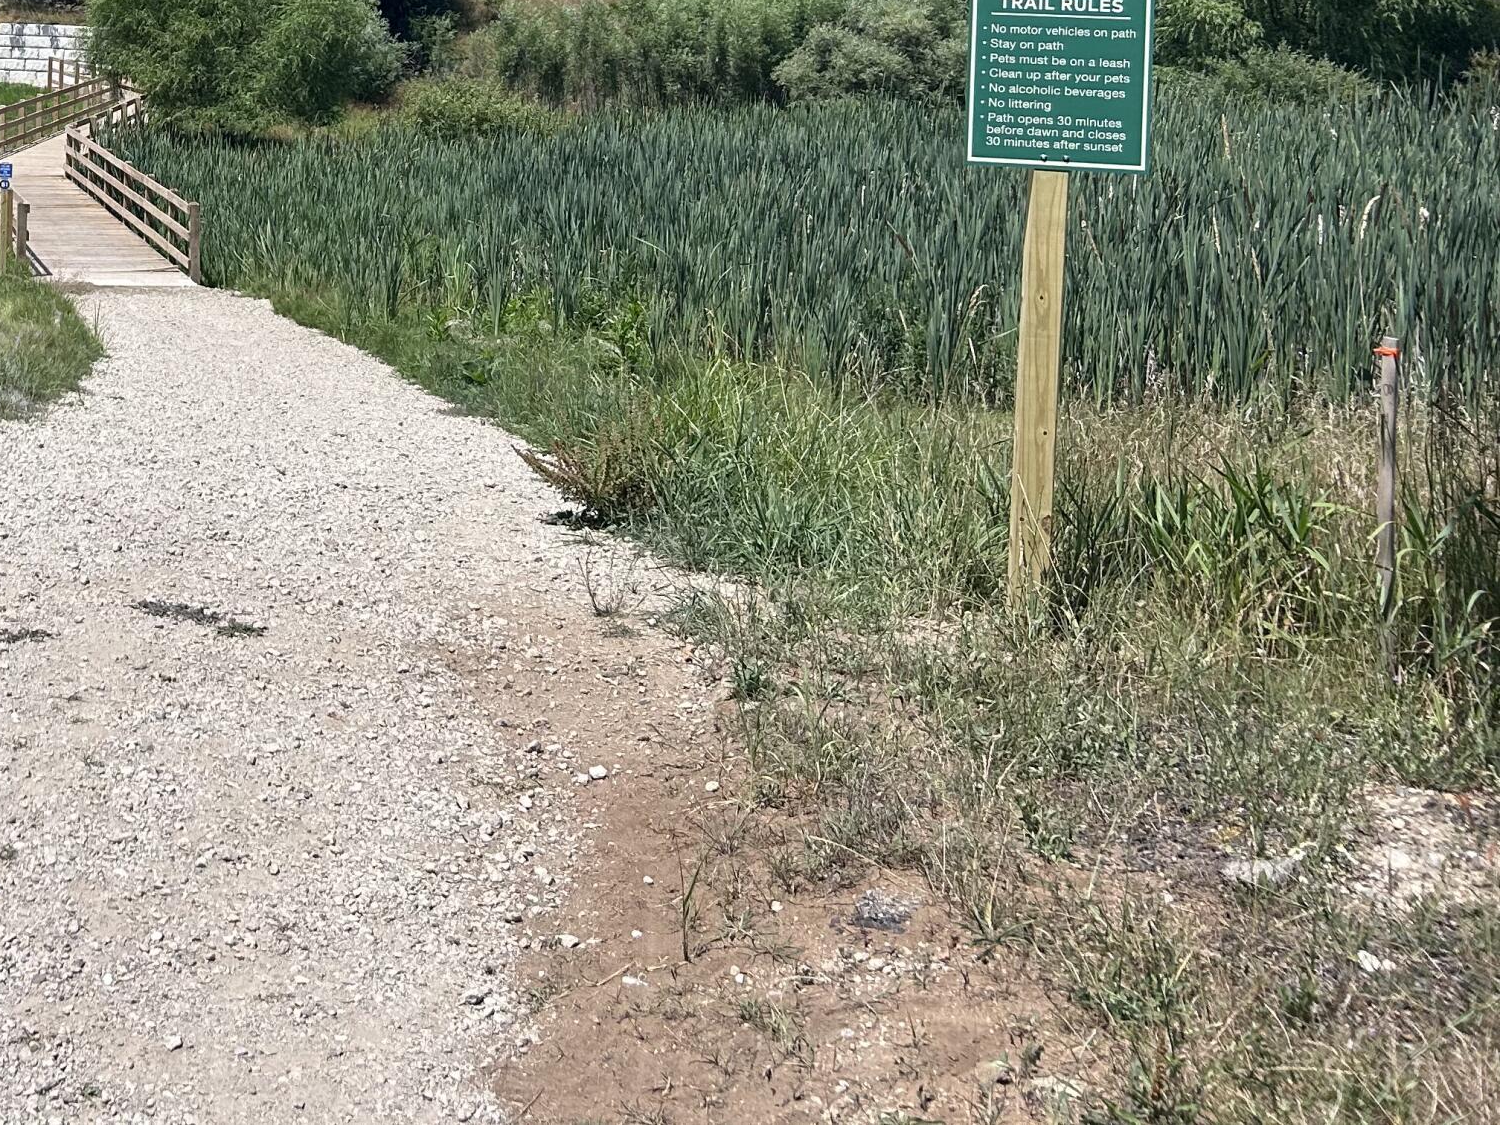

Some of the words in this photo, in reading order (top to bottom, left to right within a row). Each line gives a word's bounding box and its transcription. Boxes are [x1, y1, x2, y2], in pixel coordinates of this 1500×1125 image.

[1061, 0, 1124, 13] RULES
[991, 24, 1006, 34] No
[1010, 26, 1042, 35] motor
[1046, 27, 1090, 37] vehicles
[1093, 29, 1108, 37] on
[1111, 29, 1136, 41] path
[991, 39, 1015, 49] Stay
[1019, 41, 1034, 49] on
[1038, 40, 1063, 51] path
[990, 54, 1015, 64] Pets
[1019, 56, 1048, 65] must
[1052, 57, 1066, 66] be
[1070, 59, 1084, 67] on
[1088, 59, 1095, 67] a
[1099, 58, 1130, 68] leash
[989, 68, 1022, 78] Clean
[1026, 70, 1041, 81] up
[1044, 70, 1071, 80] after
[1075, 74, 1101, 83] your
[1105, 74, 1130, 85] pets
[989, 83, 1005, 93] No
[1009, 85, 1060, 95] alcoholic
[1065, 87, 1125, 99] beverages
[989, 98, 1005, 107] No
[1009, 99, 1051, 111] littering
[988, 113, 1014, 123] Path
[1018, 116, 1053, 125] opens
[1057, 117, 1071, 125] 30
[1075, 117, 1122, 128] minutes
[987, 125, 1023, 135] before
[1027, 127, 1058, 137] dawn
[1063, 129, 1084, 138] and
[1088, 130, 1126, 140] closes
[986, 136, 999, 146] 30
[1004, 138, 1050, 149] minutes
[1053, 139, 1080, 150] after
[1083, 142, 1122, 152] sunset
